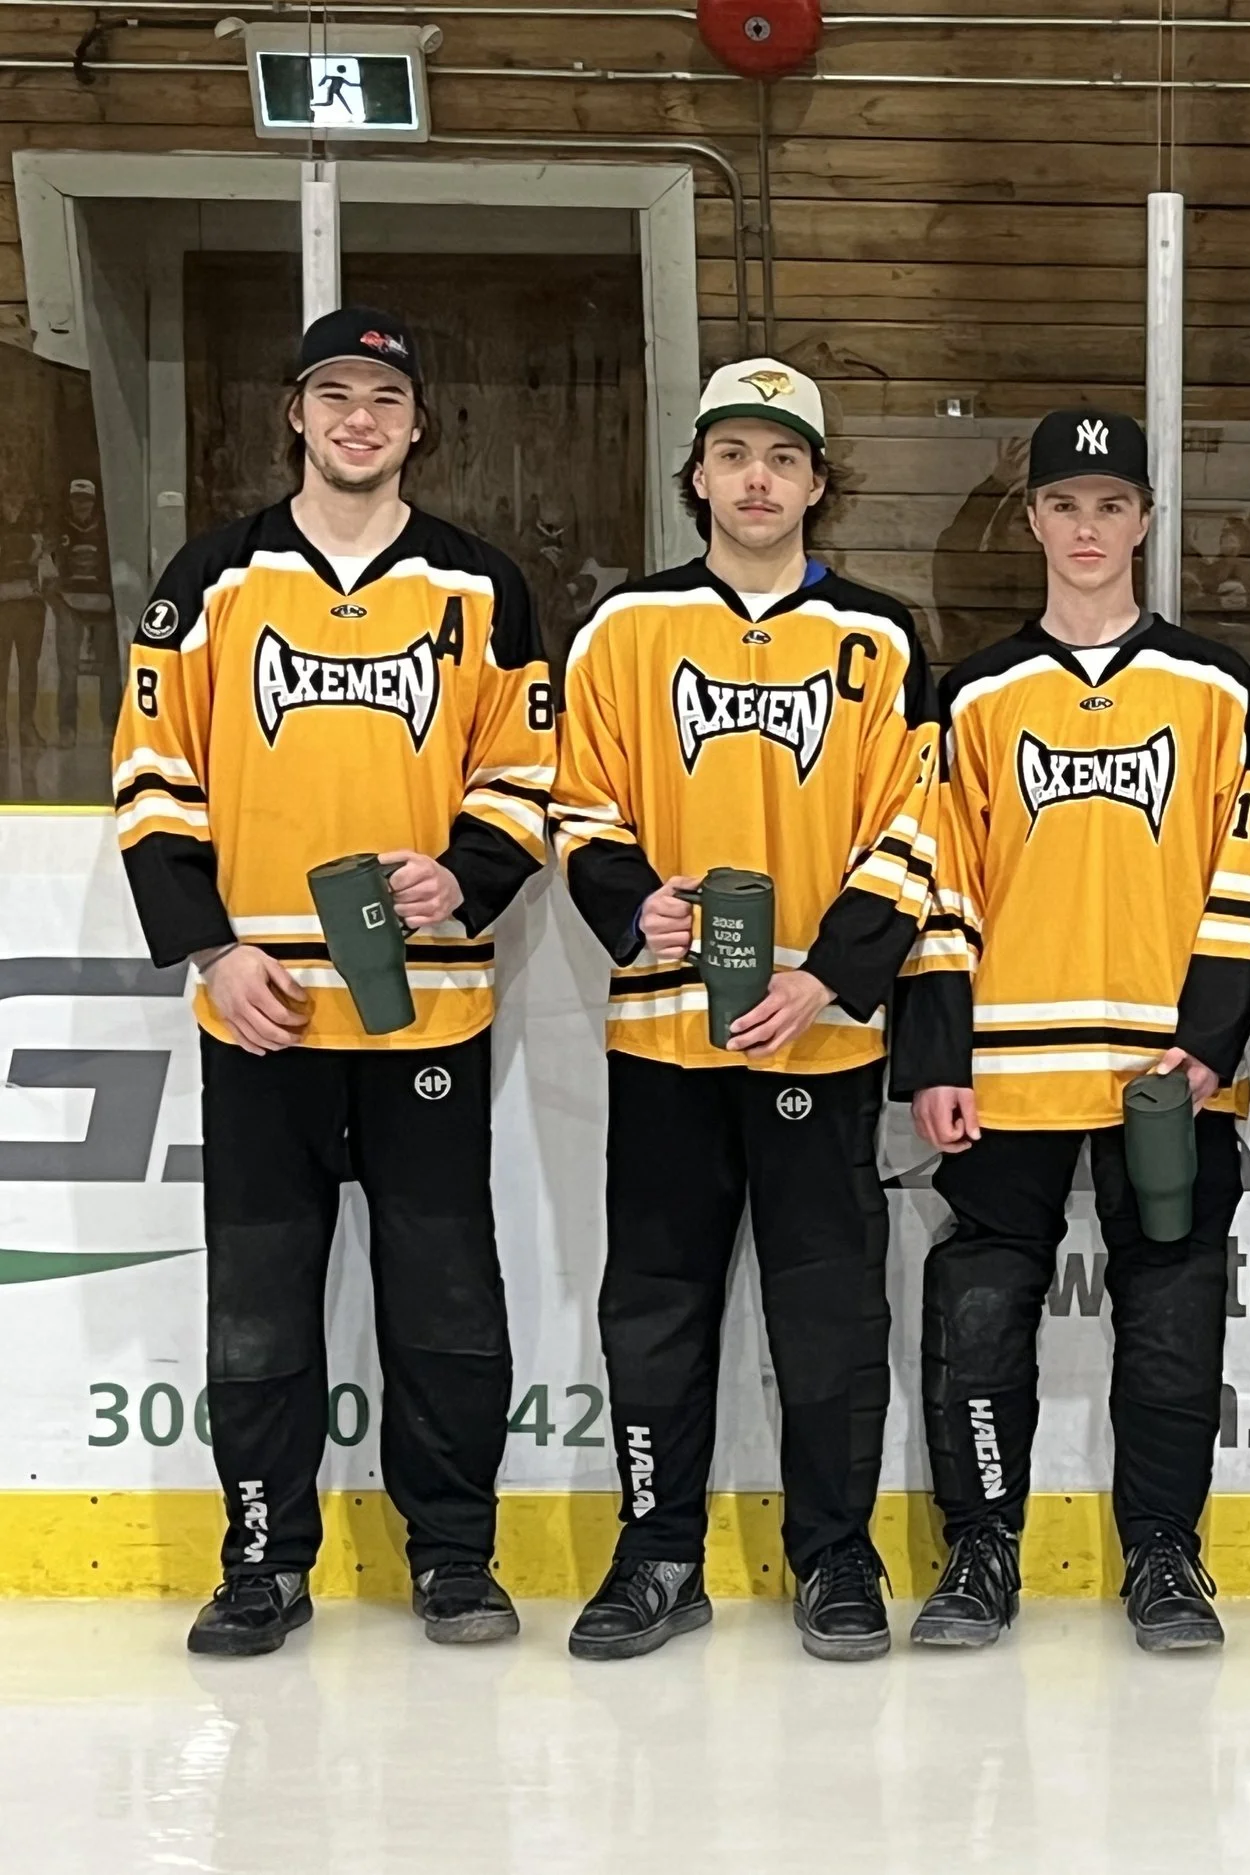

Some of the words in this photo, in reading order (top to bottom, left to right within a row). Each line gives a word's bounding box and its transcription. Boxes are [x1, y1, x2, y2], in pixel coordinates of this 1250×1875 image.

[1076, 418, 1110, 455] NY
[434, 595, 464, 667] A
[136, 668, 159, 718] 8
[257, 632, 438, 741] AXEMEN
[836, 632, 878, 703] C
[527, 683, 555, 731] 8
[1021, 734, 1171, 828] AXEMEN
[717, 945, 756, 957] TEAM
[967, 1399, 1007, 1500] HAGAN
